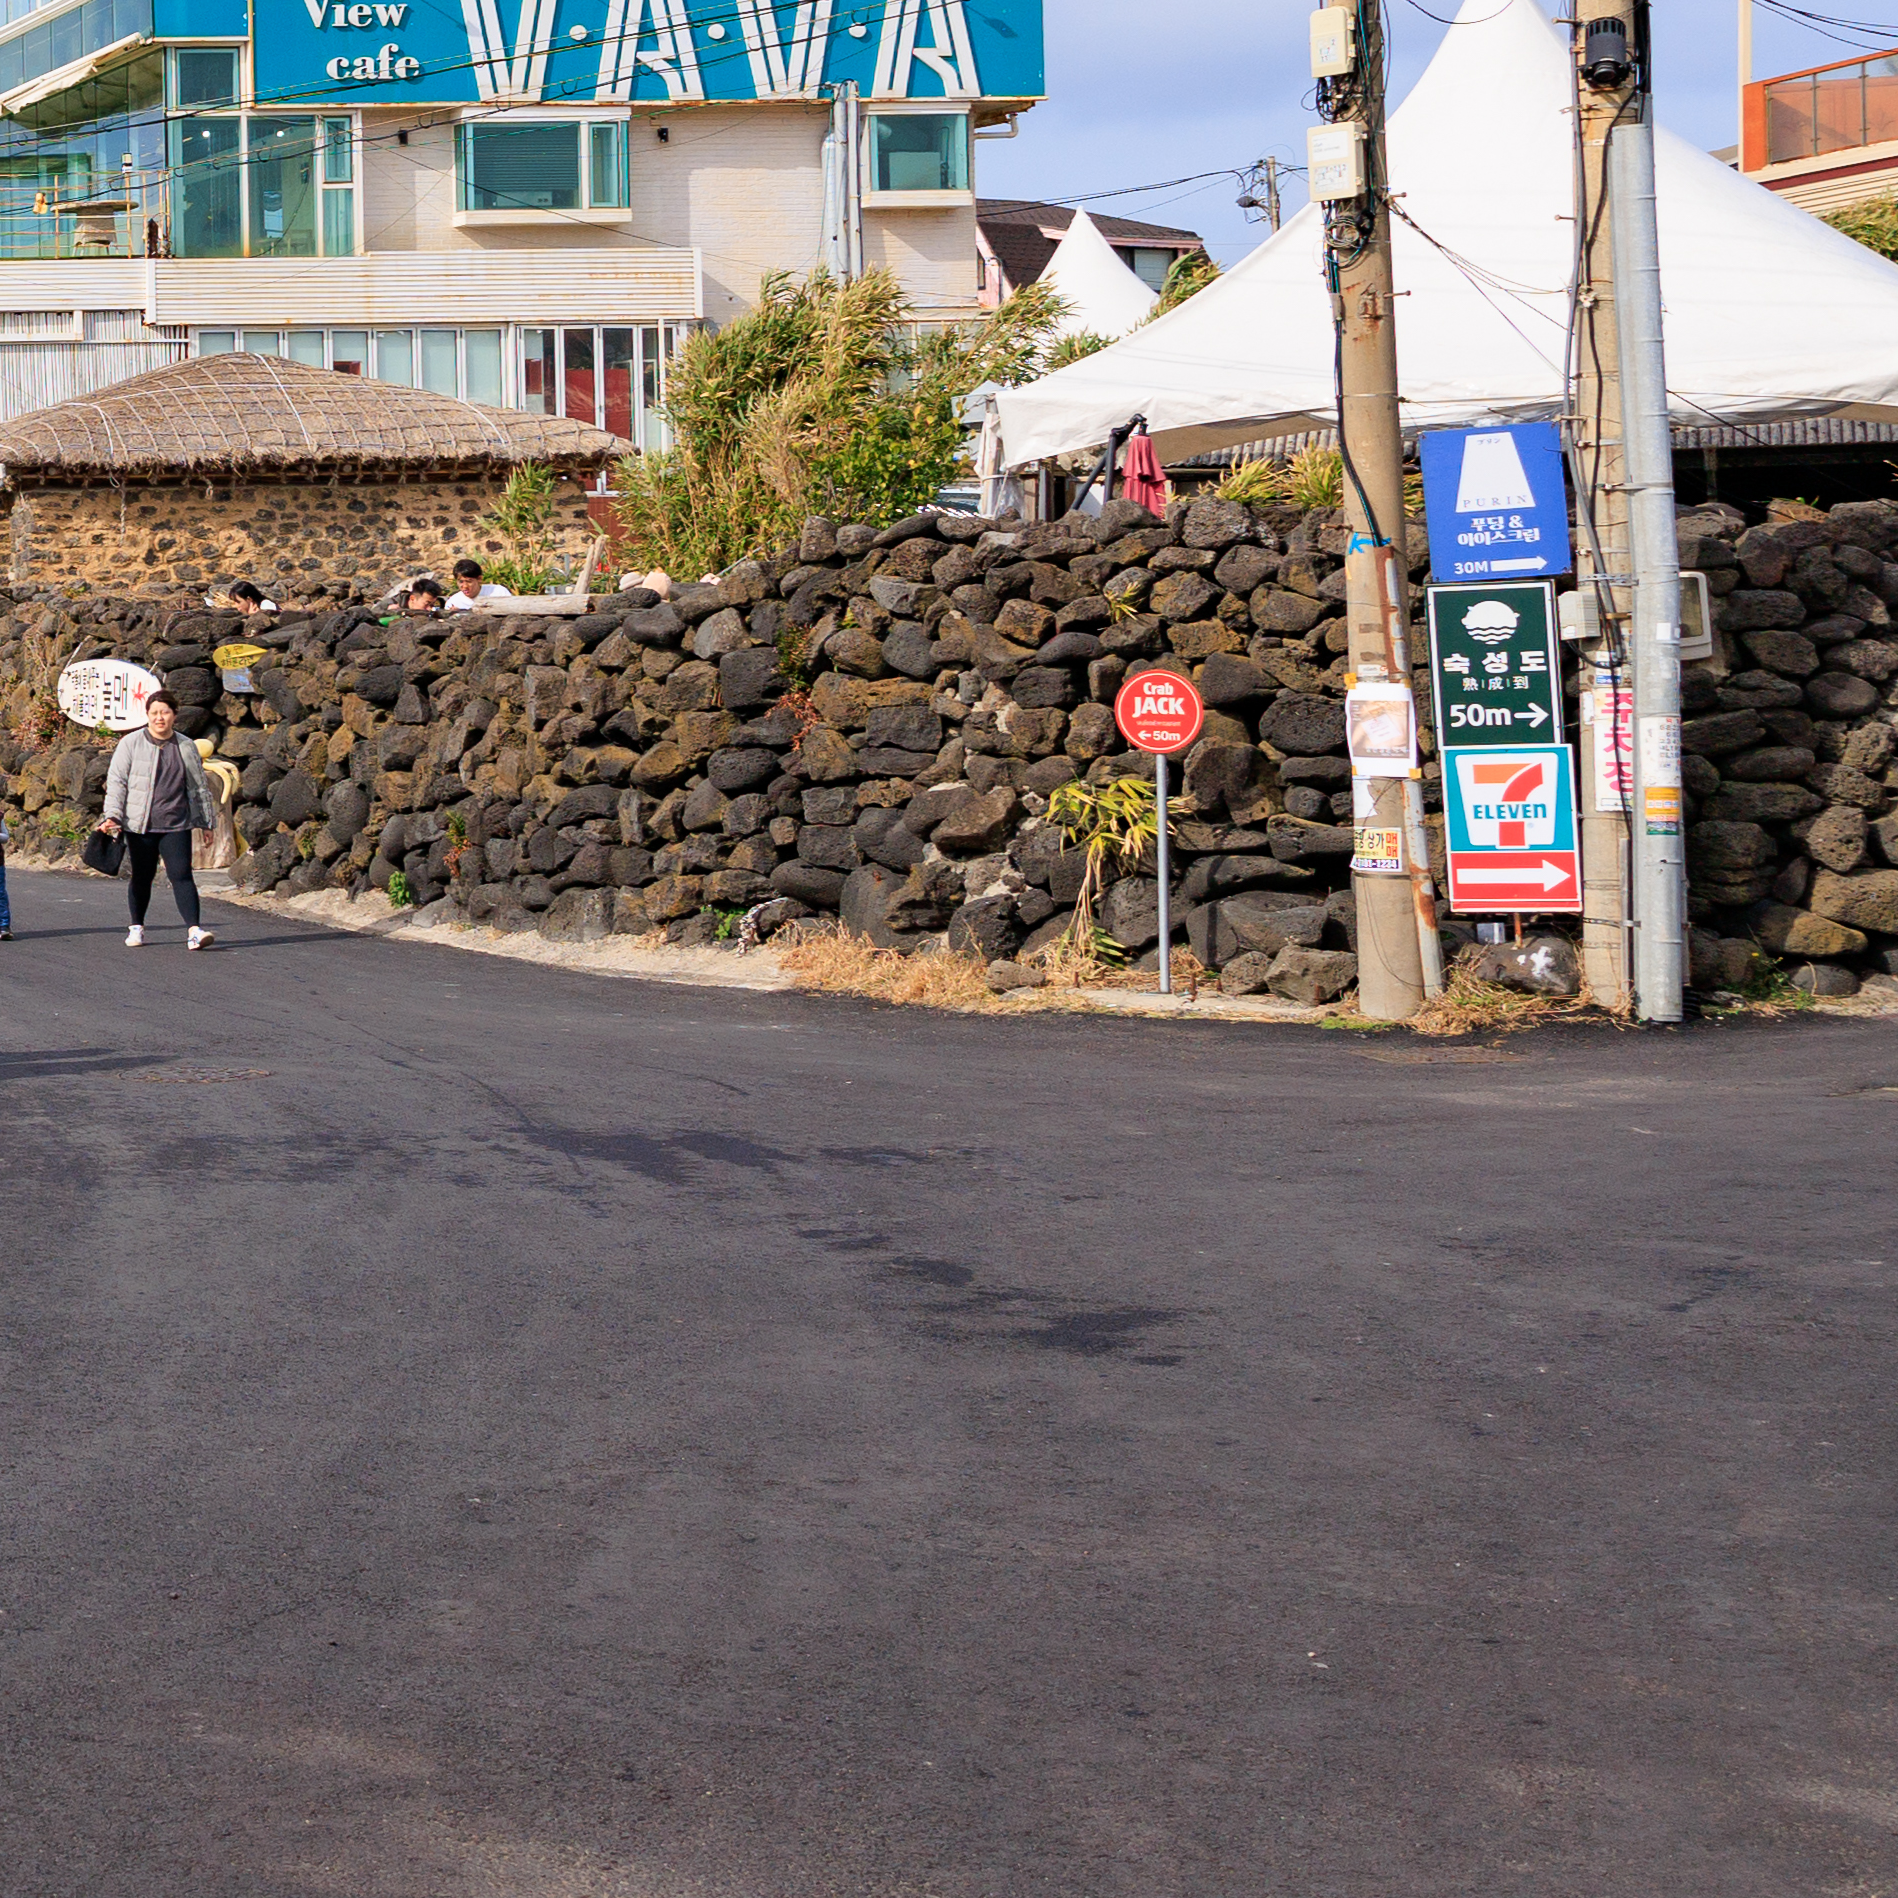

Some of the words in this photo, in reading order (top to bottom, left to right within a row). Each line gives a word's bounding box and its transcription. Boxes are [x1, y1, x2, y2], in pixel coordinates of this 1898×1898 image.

[326, 43, 421, 82] cafe
[1463, 495, 1528, 509] PURIN
[1470, 516, 1504, 532] 푸딩
[1508, 515, 1524, 529] &
[1454, 560, 1489, 575] 30M
[1443, 650, 1548, 675] 숙성도
[1143, 682, 1174, 696] Crab
[1132, 696, 1186, 718] JACK
[1450, 703, 1512, 728] 50m
[1153, 730, 1181, 742] 50m
[1472, 762, 1544, 847] 7
